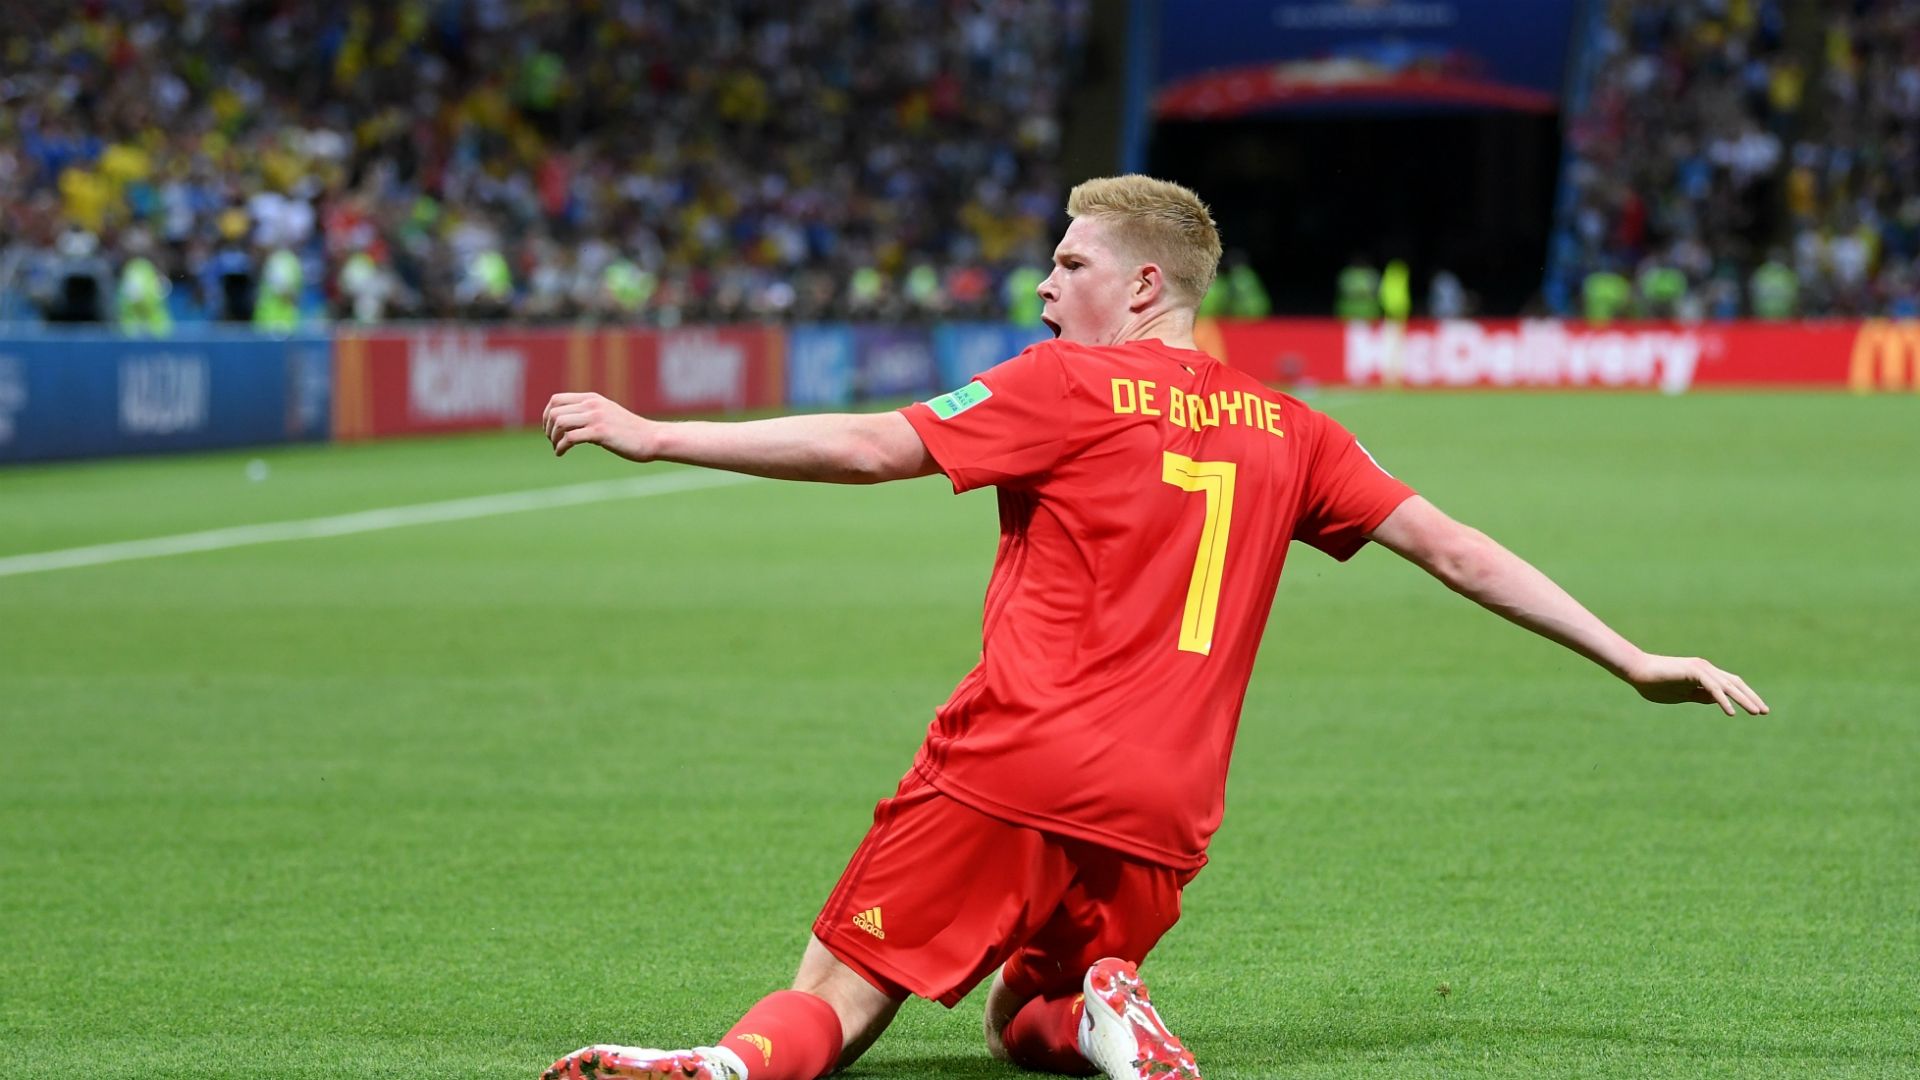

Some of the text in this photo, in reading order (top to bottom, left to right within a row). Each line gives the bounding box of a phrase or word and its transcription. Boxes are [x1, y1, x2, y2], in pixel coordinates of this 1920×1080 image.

[1344, 320, 1700, 394] McDelivery
[1111, 378, 1284, 438] DE BRUYNE
[1162, 450, 1237, 656] 7
